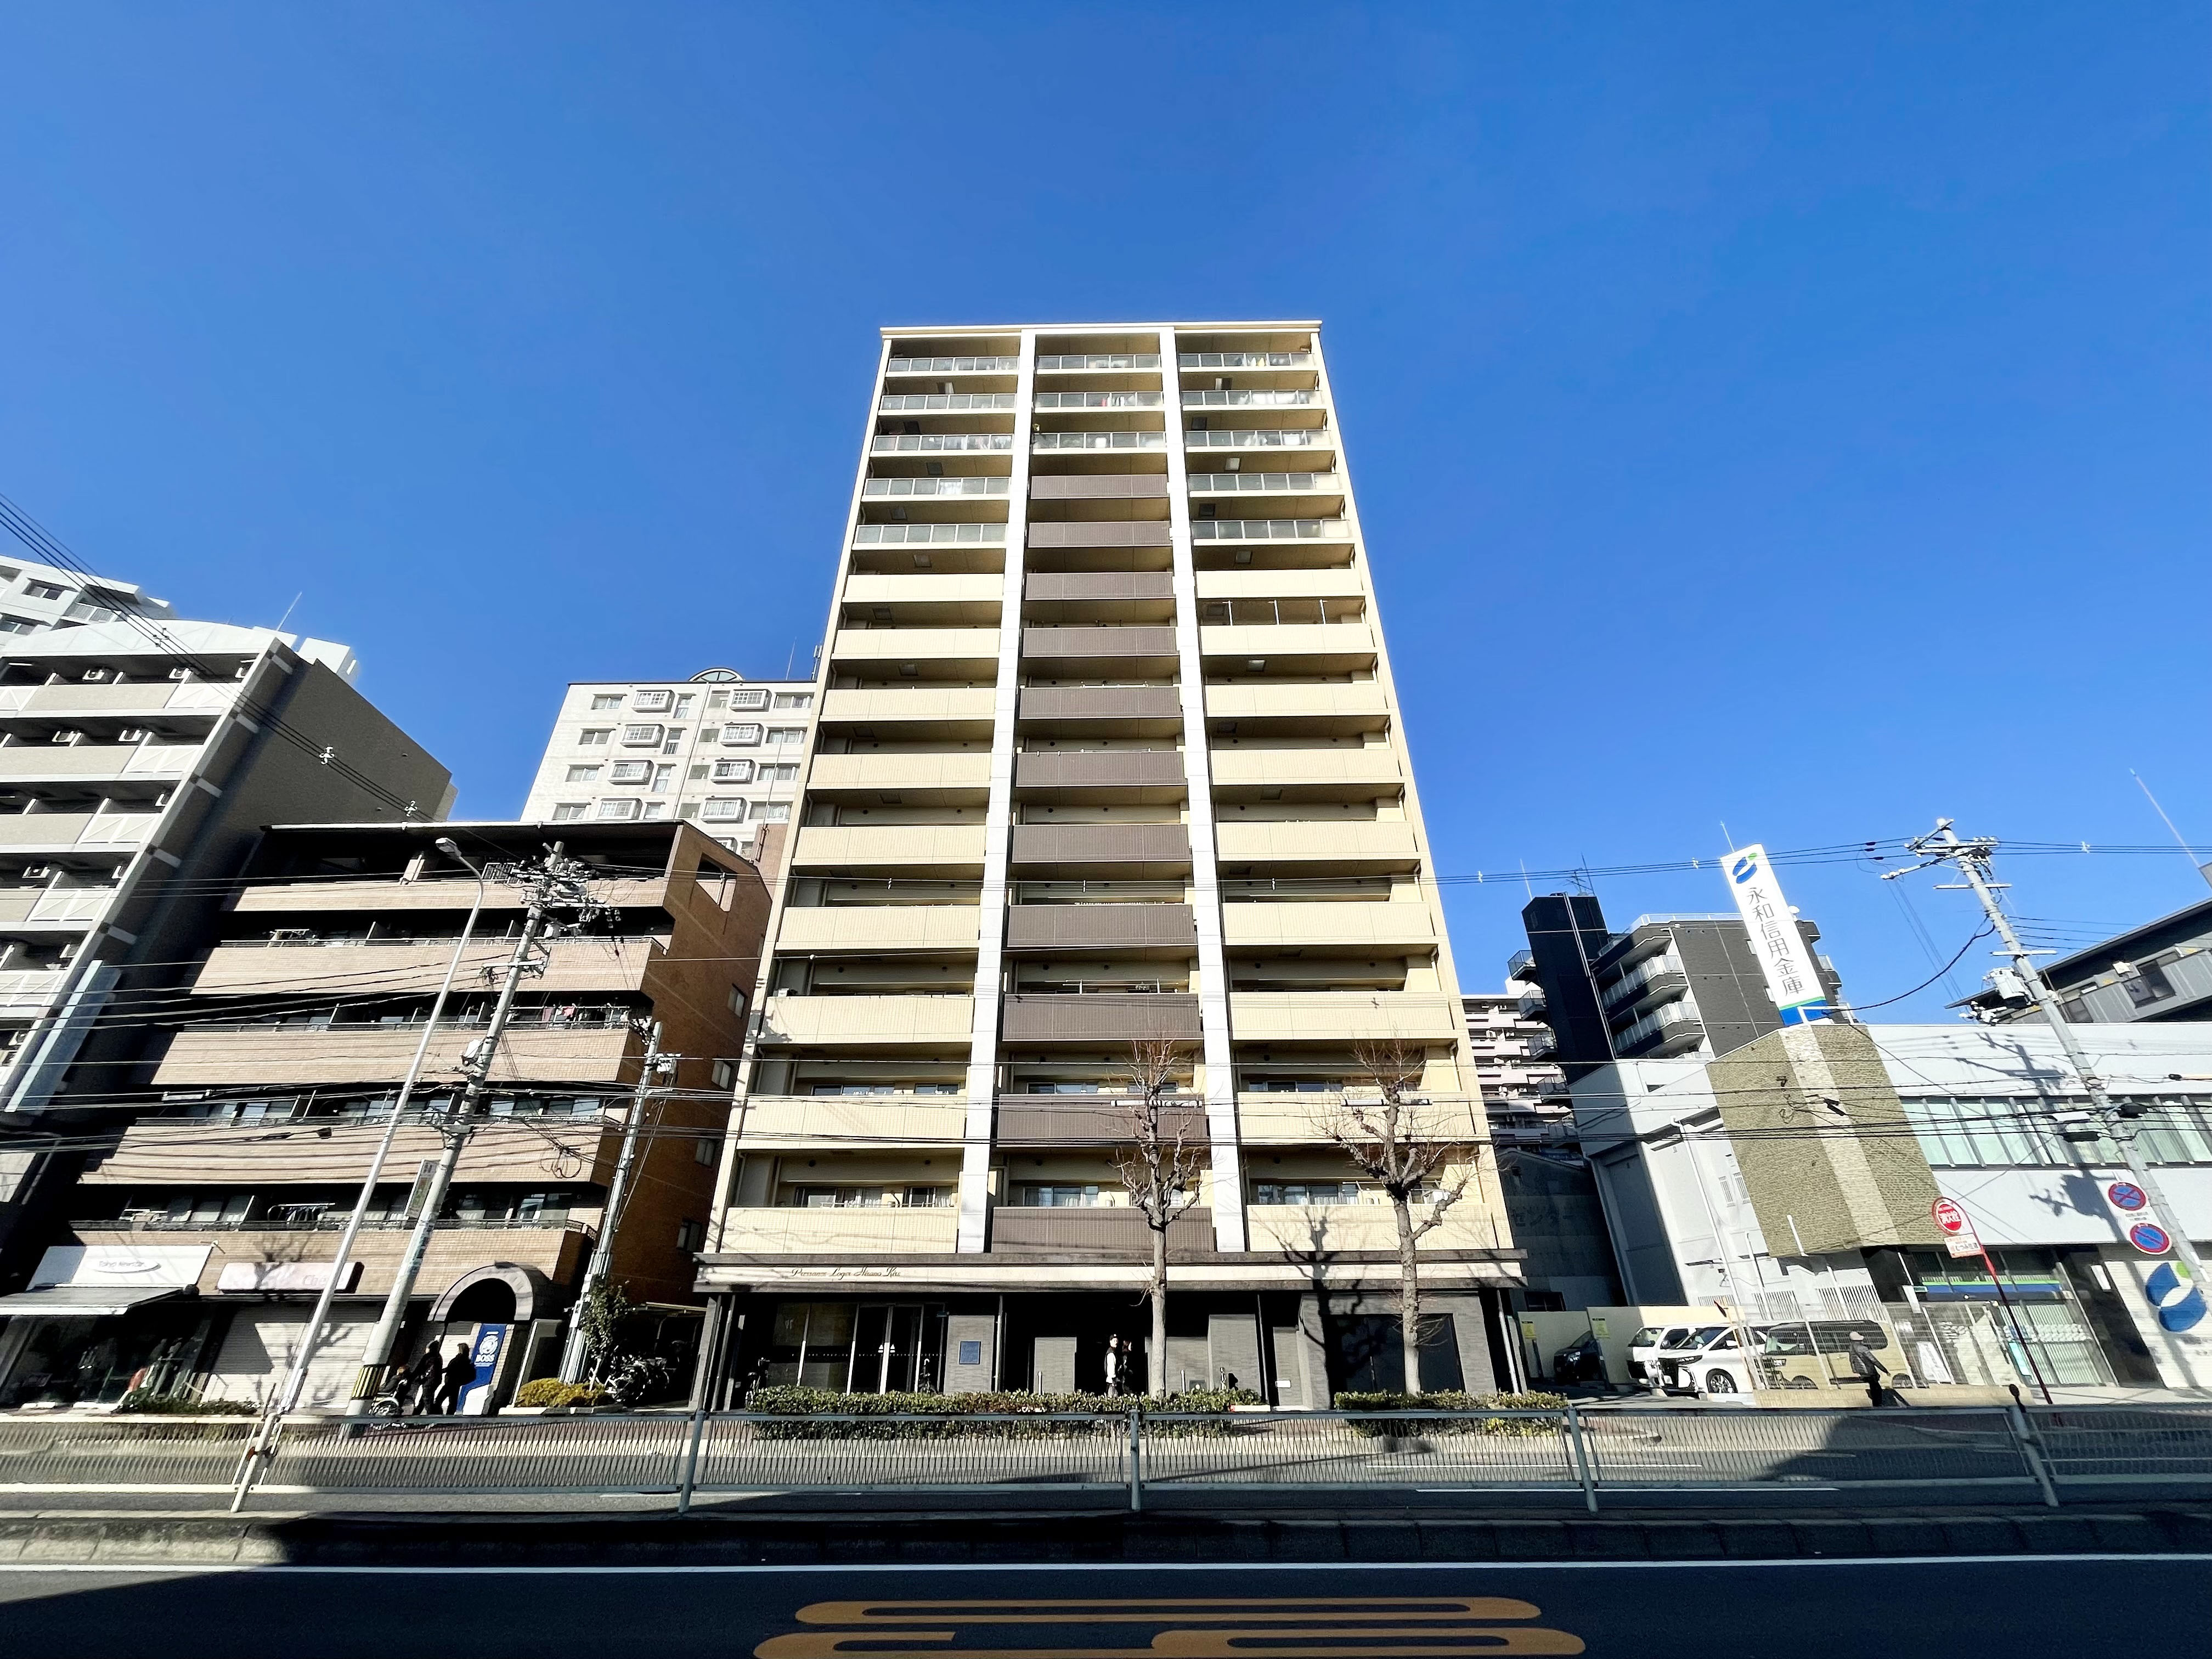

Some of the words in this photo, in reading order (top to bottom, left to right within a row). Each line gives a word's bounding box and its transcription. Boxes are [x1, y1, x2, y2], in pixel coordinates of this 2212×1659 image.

[1747, 887, 1805, 996] 永和信用金庫
